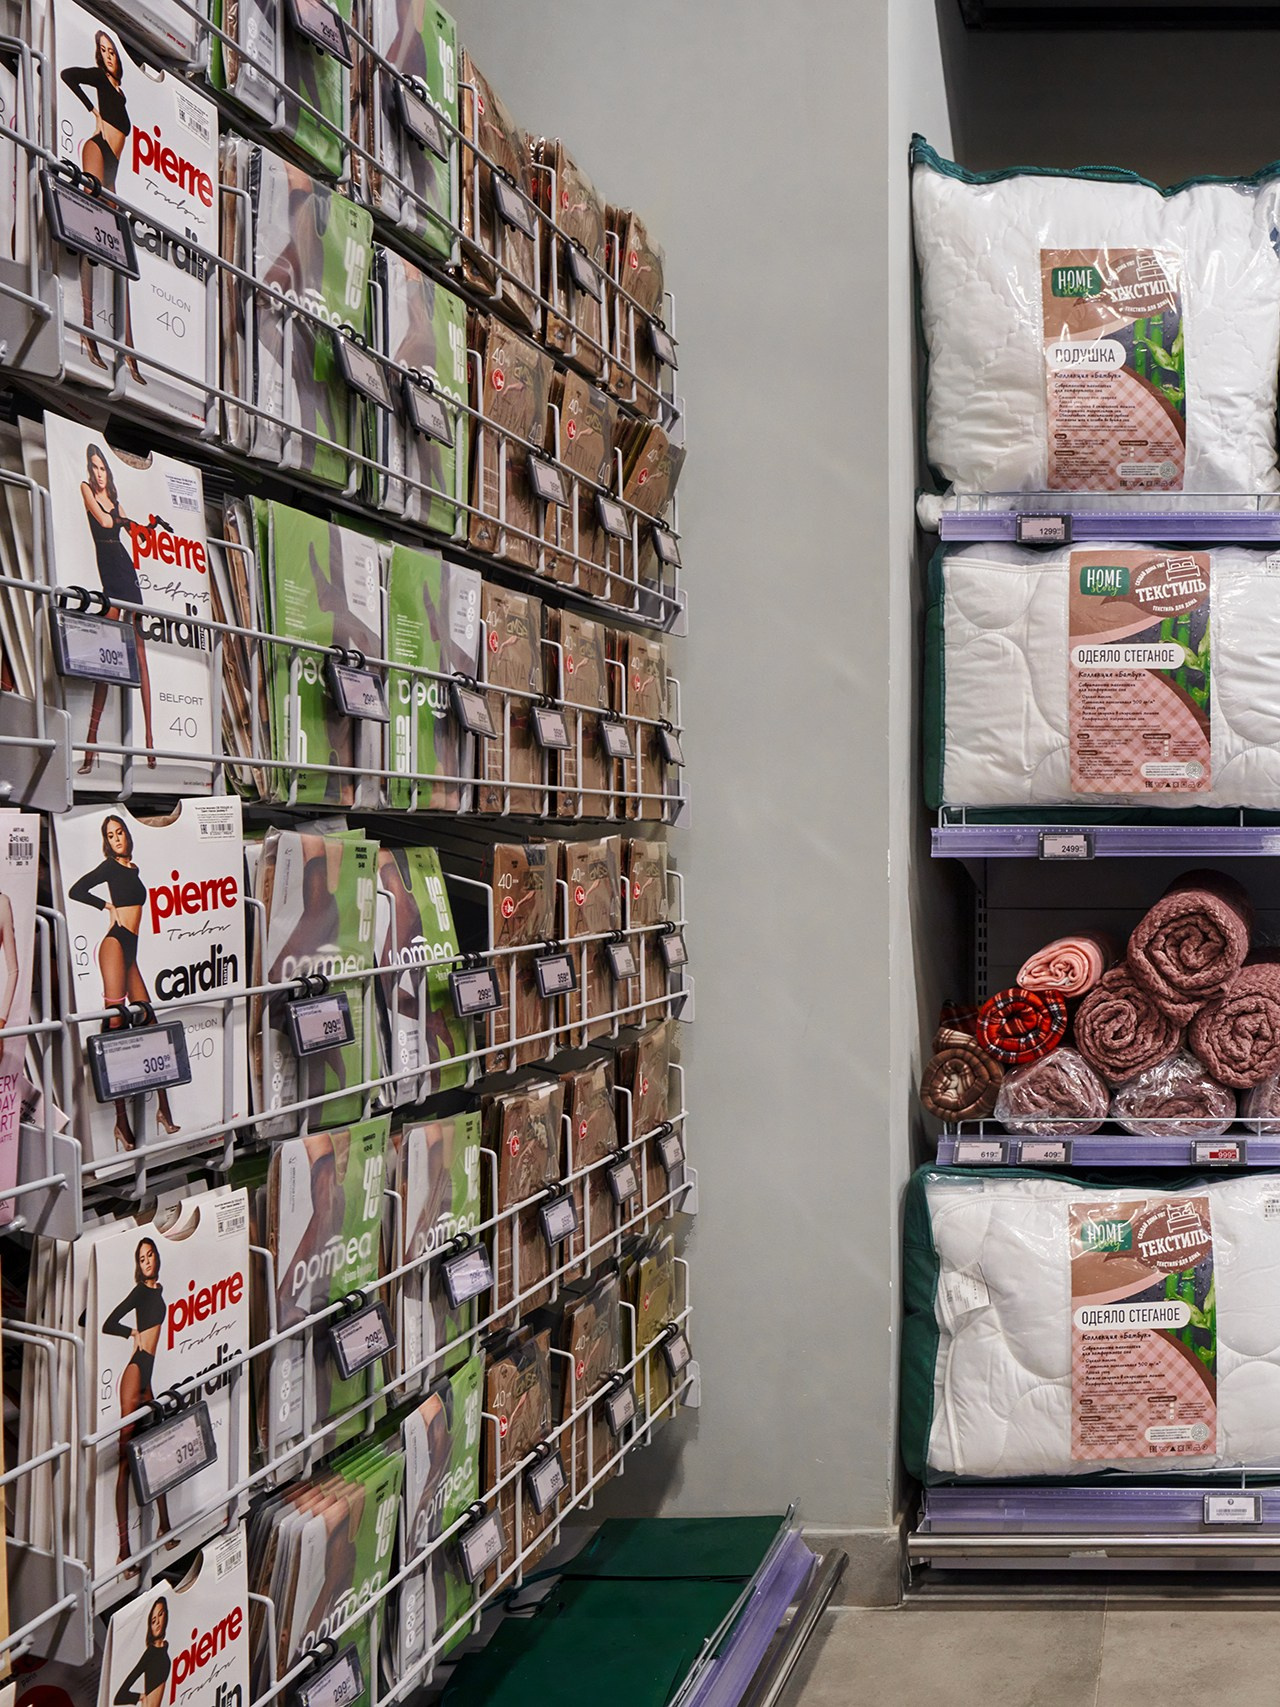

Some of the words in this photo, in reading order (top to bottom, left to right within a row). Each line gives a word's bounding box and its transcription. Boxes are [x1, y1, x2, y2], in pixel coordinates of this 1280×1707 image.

[132, 124, 214, 208] pierre
[93, 226, 115, 249] 379
[1058, 270, 1093, 289] HOME
[150, 283, 191, 312] TOULON
[156, 311, 186, 338] 40
[1056, 349, 1115, 364] ПОДУШКА
[1039, 527, 1057, 536] 1299
[131, 513, 207, 574] pierre
[1088, 569, 1122, 587] HOME
[1135, 579, 1206, 602] ТЕКСТИЛЬ
[100, 647, 118, 665] 309
[1079, 650, 1120, 664] ОДЕЯЛО
[1125, 650, 1174, 662] СТЕГАНОЕ
[159, 692, 204, 706] BELFORT
[169, 716, 198, 738] 40
[1061, 844, 1080, 853] 2499
[498, 873, 512, 890] 40
[149, 869, 238, 935] pierre
[74, 935, 90, 981] 150
[155, 943, 238, 1002] cardin
[322, 1020, 338, 1035] 299
[188, 1037, 215, 1061] 40
[143, 1055, 165, 1074] 309
[980, 1151, 995, 1159] 619
[1044, 1151, 1058, 1159] 409
[1218, 1151, 1231, 1159] 999
[1088, 1222, 1124, 1244] HOME
[1138, 1229, 1208, 1258] ТЕКСТИЛЬ
[292, 1231, 372, 1297] pompea
[168, 1271, 243, 1351] pierre
[1082, 1310, 1125, 1326] ОДЕЯЛО
[1130, 1307, 1180, 1323] СТЕГАНОЕ
[364, 1331, 379, 1349] 299
[175, 1442, 195, 1464] 379
[169, 1606, 243, 1706] pierre
[333, 1681, 348, 1702] 299
